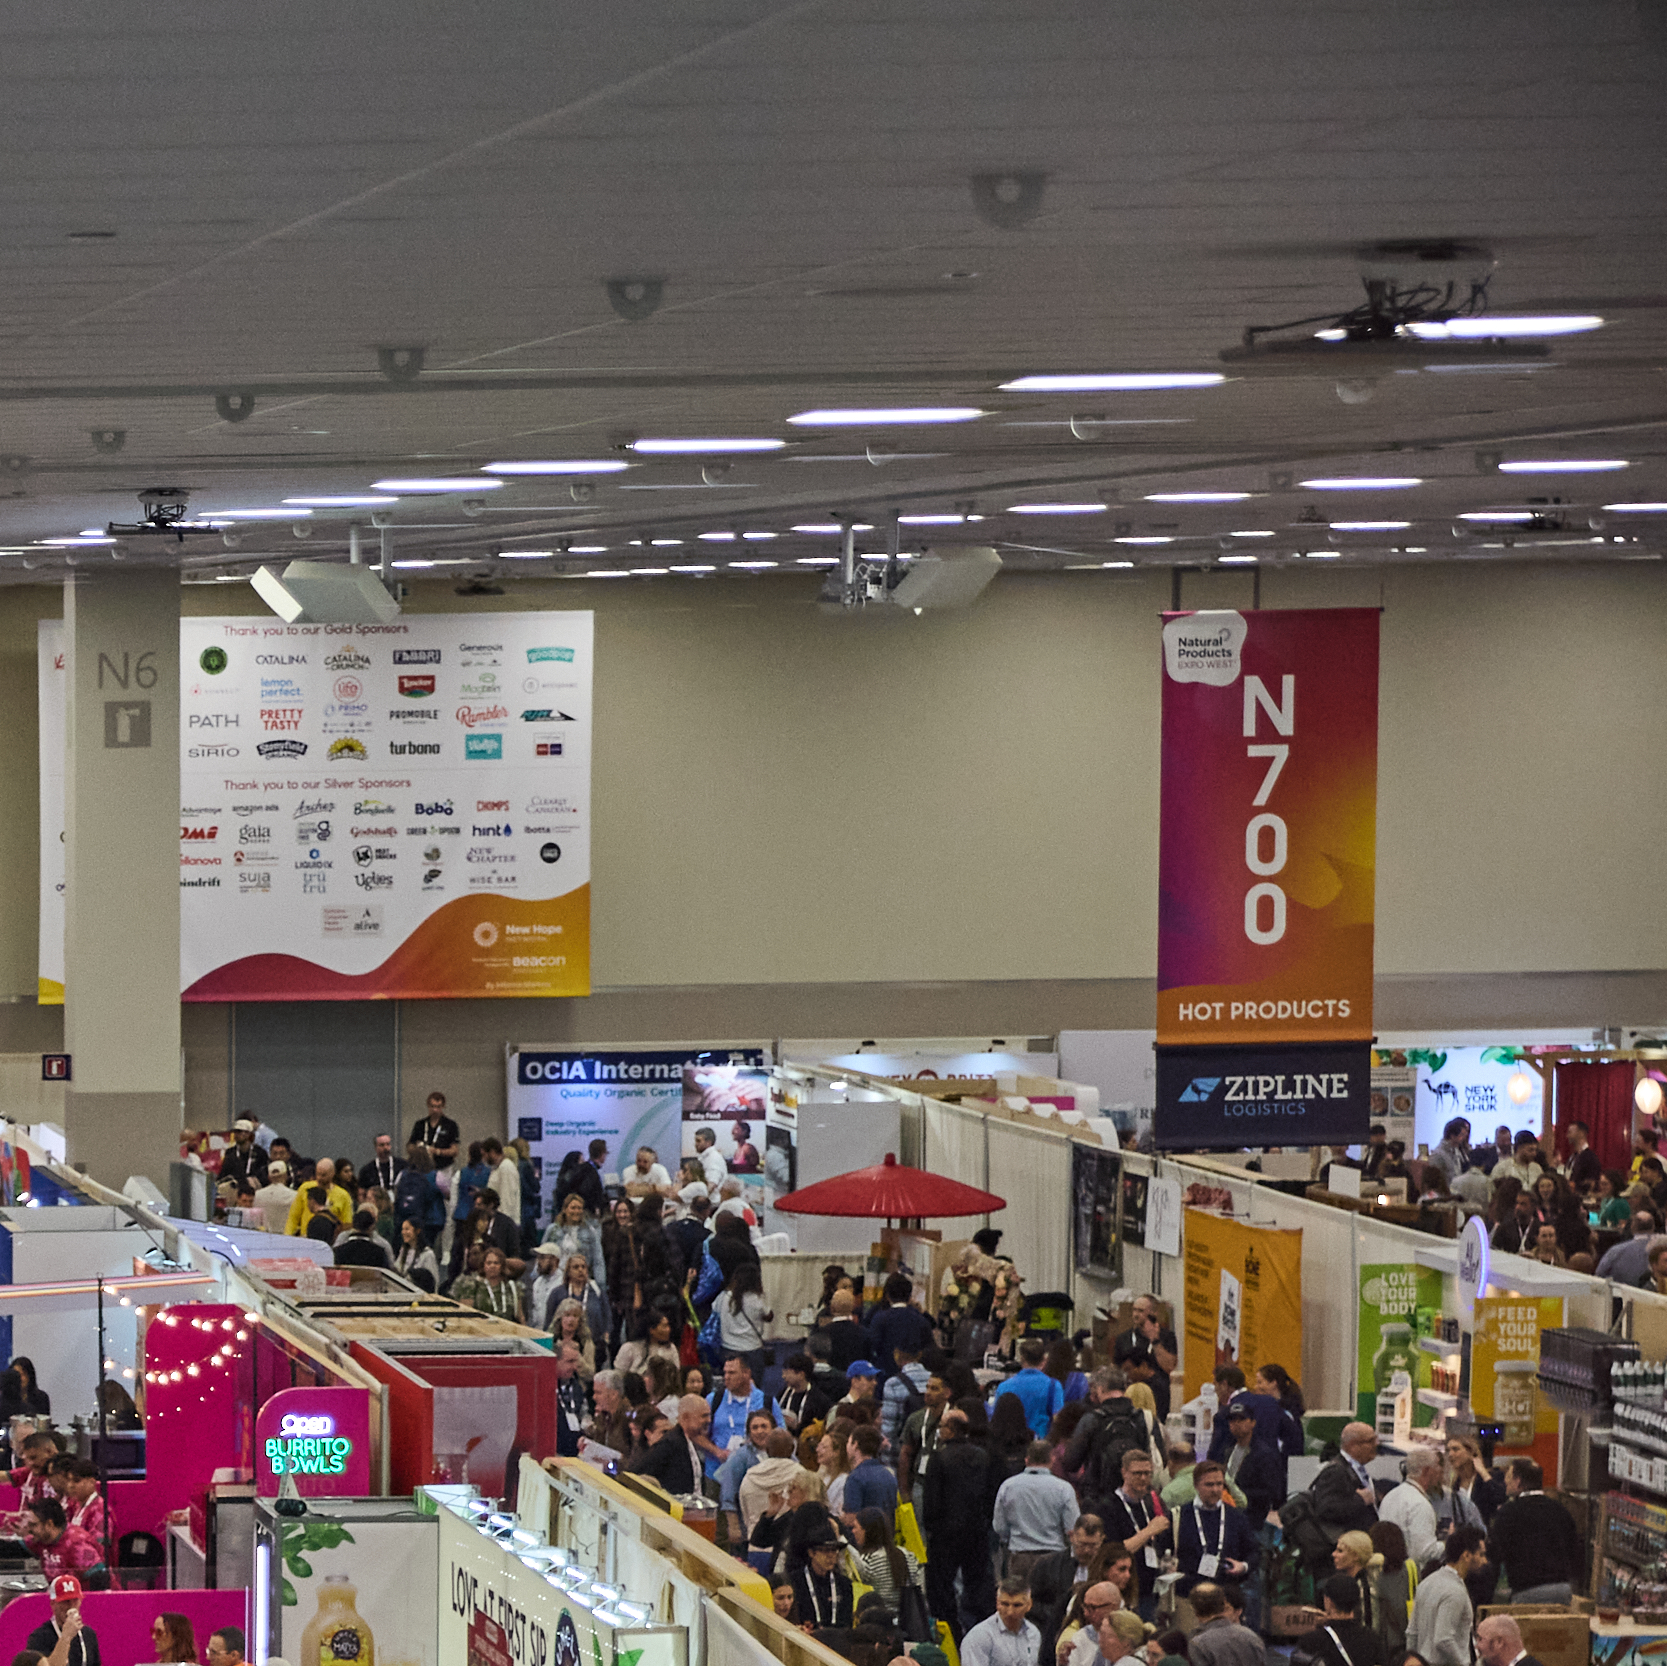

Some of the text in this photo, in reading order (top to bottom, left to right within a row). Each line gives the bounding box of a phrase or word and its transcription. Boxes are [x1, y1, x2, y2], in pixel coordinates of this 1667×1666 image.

[224, 623, 408, 638] Thank you to our Gold Sponsors
[1178, 636, 1222, 647] Natural
[256, 655, 306, 664] CATALINA
[1178, 648, 1232, 660] Products
[98, 650, 158, 690] N6
[1178, 660, 1235, 669] EXPO WEST
[261, 678, 292, 686] lemon
[189, 714, 239, 727] PATH
[260, 709, 303, 719] PRETTY
[390, 710, 438, 719] PROMOBILE
[263, 720, 300, 730] TASTY
[189, 748, 239, 757] SIRIO
[225, 779, 411, 791] Thank you to our Silver Sponsors
[416, 802, 453, 815] Bobo
[239, 824, 271, 844] gaia
[472, 825, 501, 836] hint
[354, 921, 379, 930] alive
[506, 925, 562, 934] New Hope
[1179, 1000, 1350, 1021] HOT PRODUCTS
[525, 1060, 586, 1080] OCIA
[559, 1086, 646, 1100] Quality Organic
[1224, 1074, 1348, 1100] ZIPLINE
[1464, 1085, 1496, 1096] NEW
[1464, 1094, 1498, 1105] YORK
[1224, 1103, 1306, 1116] LOGISTICS
[1463, 1102, 1498, 1113] SHUK
[1380, 1272, 1417, 1286] LOVE
[1379, 1287, 1417, 1301] YOUR
[1379, 1302, 1417, 1317] BODY
[1496, 1306, 1538, 1321] FEED
[1496, 1322, 1538, 1337] YOUR
[1497, 1337, 1538, 1352] SOUL
[280, 1414, 331, 1437] Open
[265, 1438, 350, 1458] BURRITO
[271, 1455, 344, 1475] BOWLS
[61, 1580, 75, 1593] M
[450, 1560, 477, 1625] LOVE
